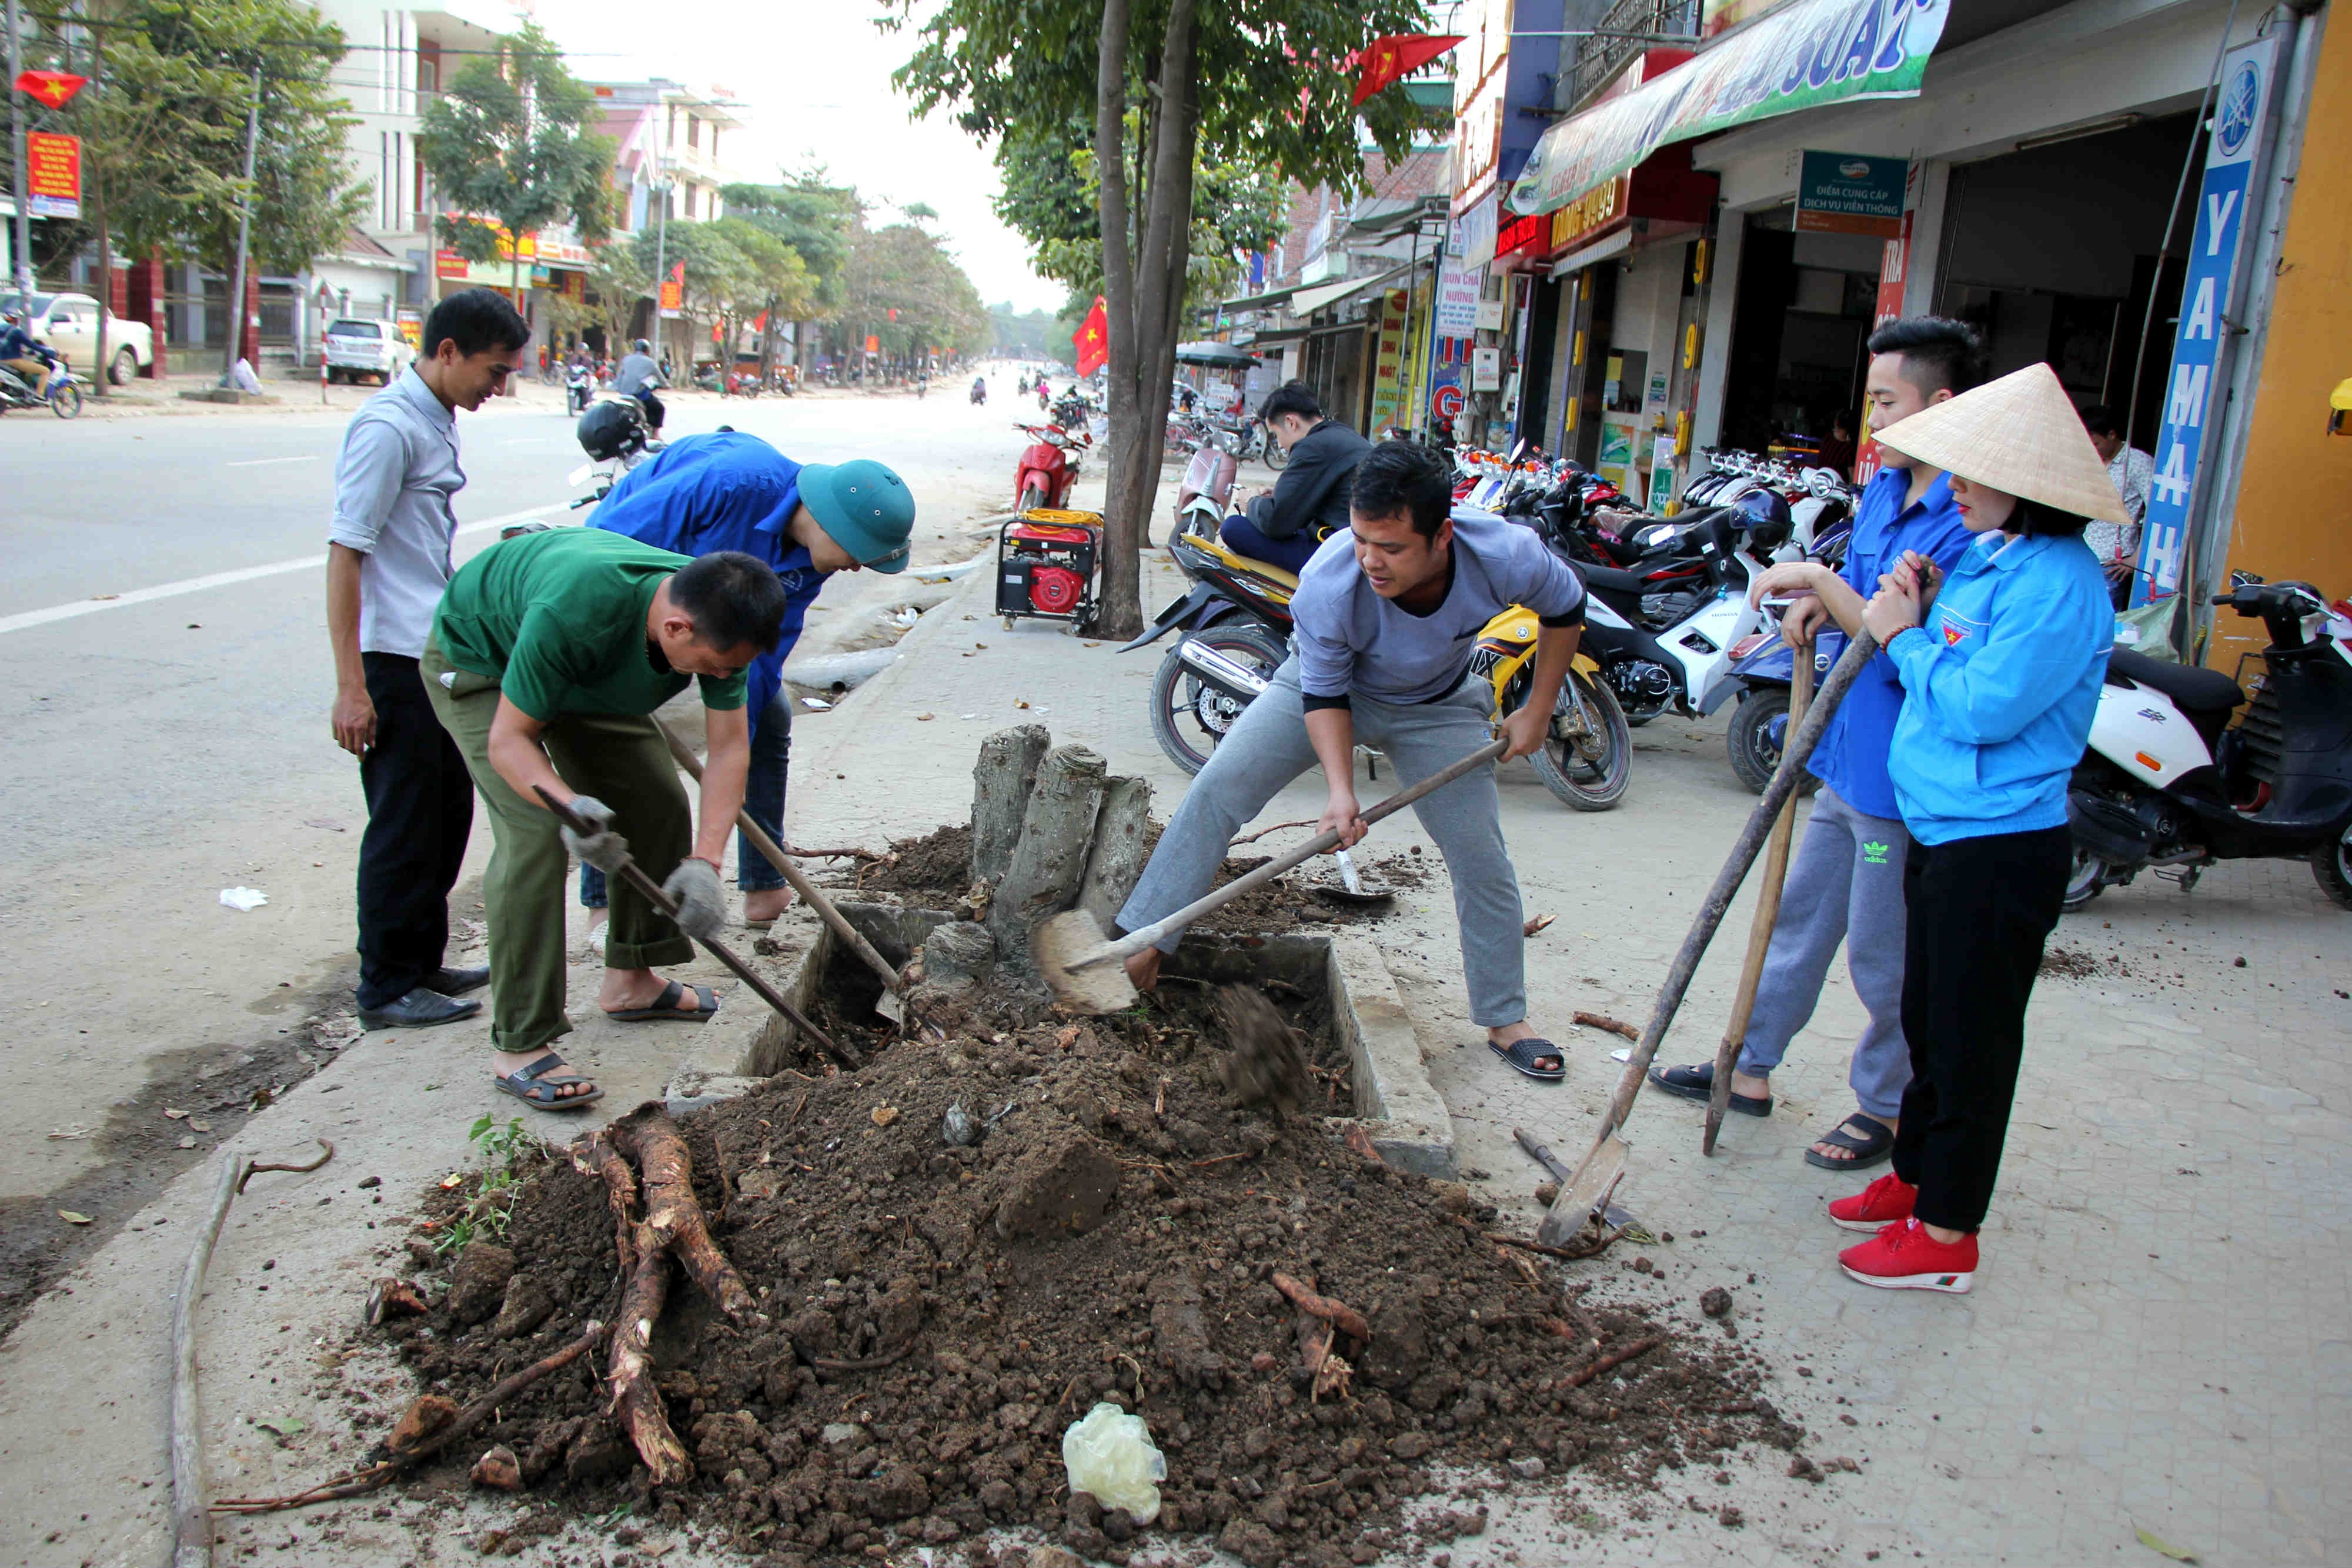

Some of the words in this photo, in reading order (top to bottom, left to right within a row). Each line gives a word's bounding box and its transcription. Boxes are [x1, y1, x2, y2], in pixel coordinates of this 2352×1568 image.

[1842, 188, 1867, 199] CUNG
[1870, 188, 1889, 200] CẤP
[1804, 198, 1827, 209] DỊCH
[1829, 200, 1842, 212] VỤ
[1866, 202, 1898, 215] THÔNG
[2140, 189, 2239, 607] YAMAH
[1864, 855, 1887, 864] adidas
